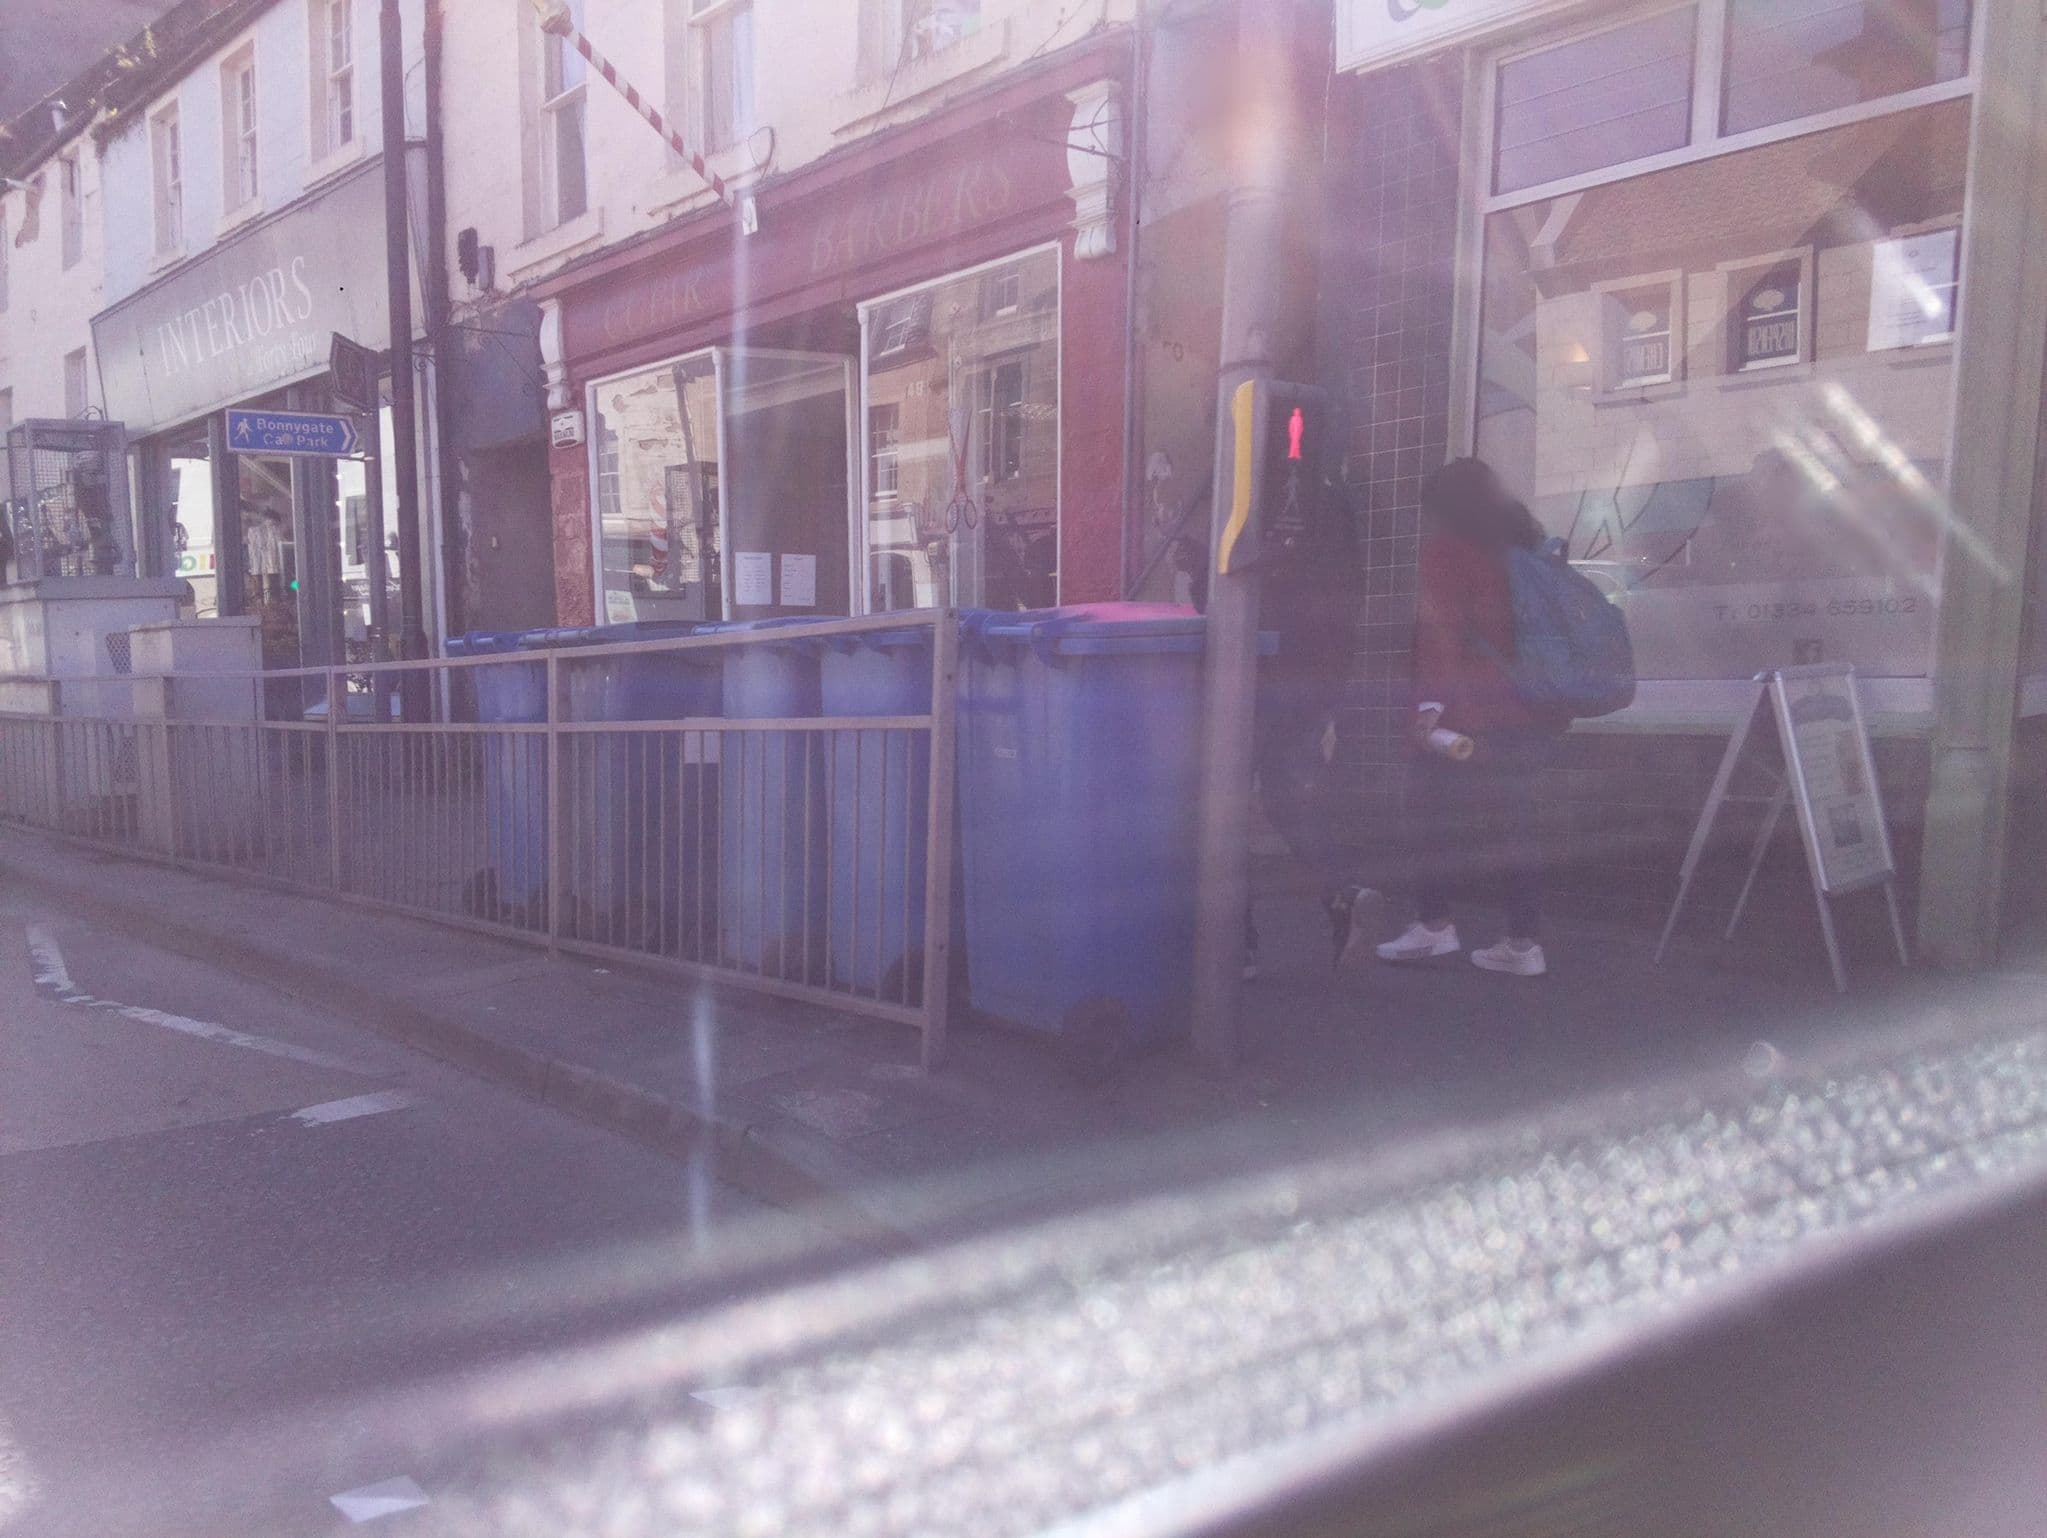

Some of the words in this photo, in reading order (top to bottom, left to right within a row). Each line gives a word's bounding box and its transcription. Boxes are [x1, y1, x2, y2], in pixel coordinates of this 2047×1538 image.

[811, 158, 1010, 273] BARBERS
[157, 256, 313, 376] INTERIORS
[256, 417, 335, 435] Bonnygate
[296, 434, 329, 447] Park
